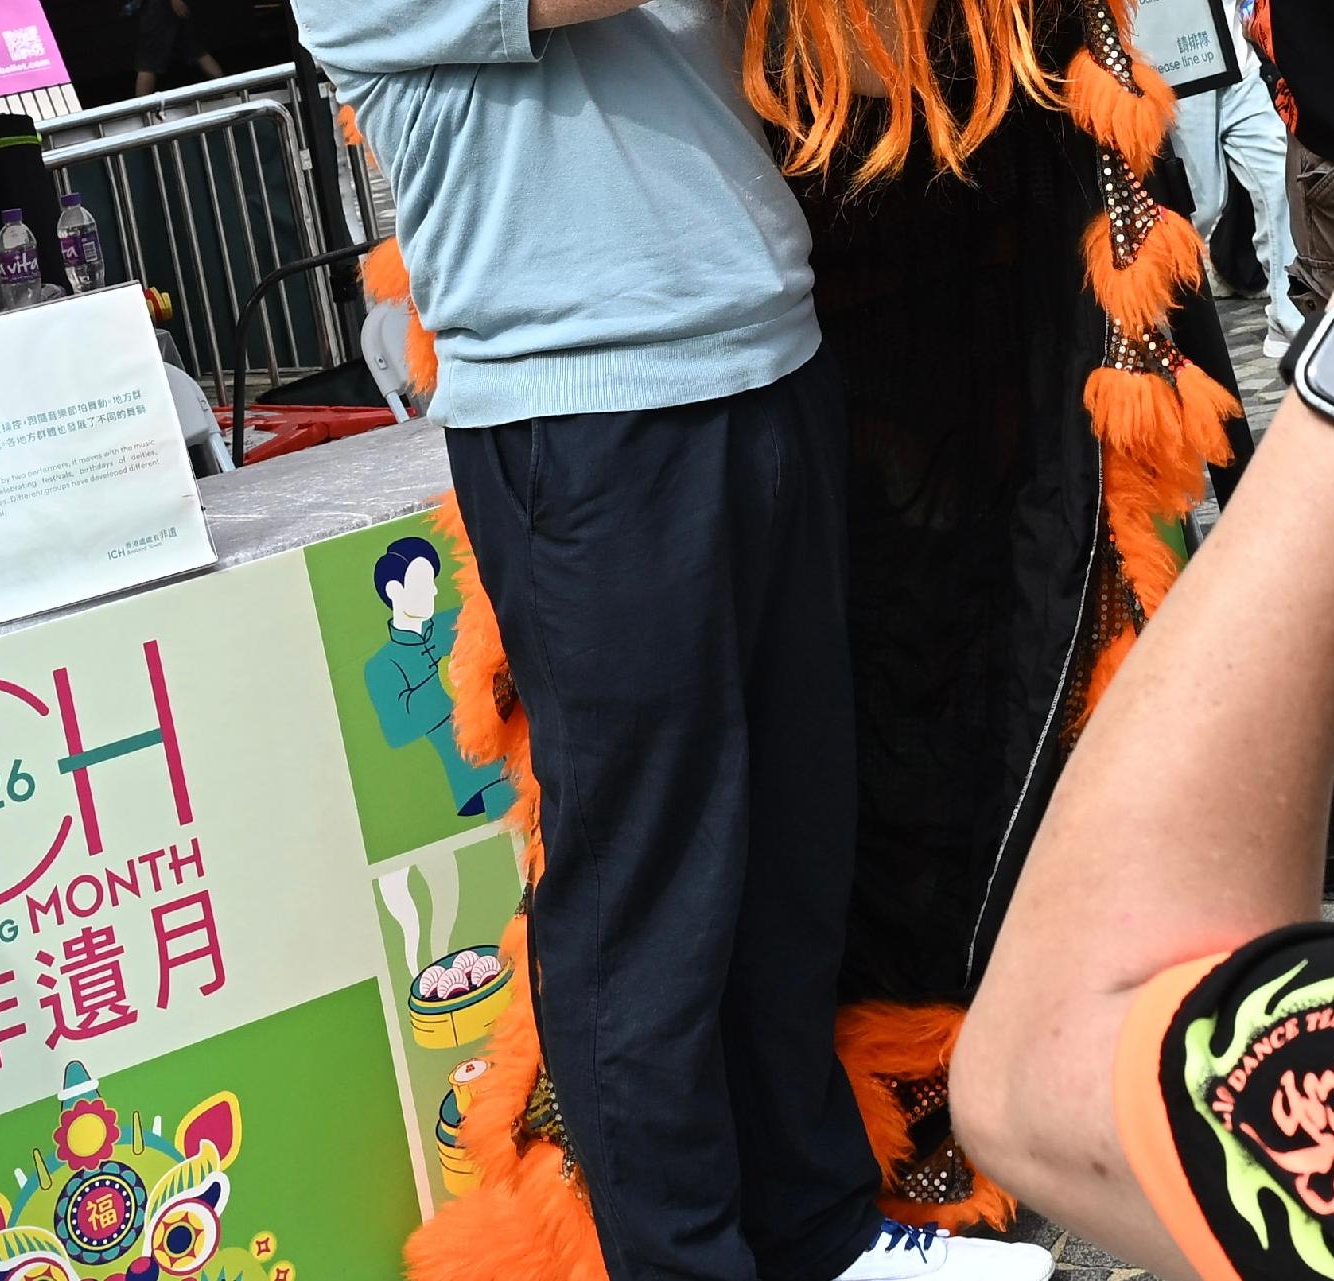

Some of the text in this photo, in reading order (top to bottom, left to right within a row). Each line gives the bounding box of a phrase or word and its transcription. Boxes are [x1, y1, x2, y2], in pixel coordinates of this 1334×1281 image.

[1176, 30, 1211, 55] 請排隊
[1182, 53, 1200, 68] line
[1201, 51, 1215, 66] up
[133, 438, 155, 450] music
[107, 546, 126, 561] ICH
[25, 836, 206, 935] MONTH
[1227, 1017, 1300, 1093] DANCE
[86, 1193, 117, 1231] 福
